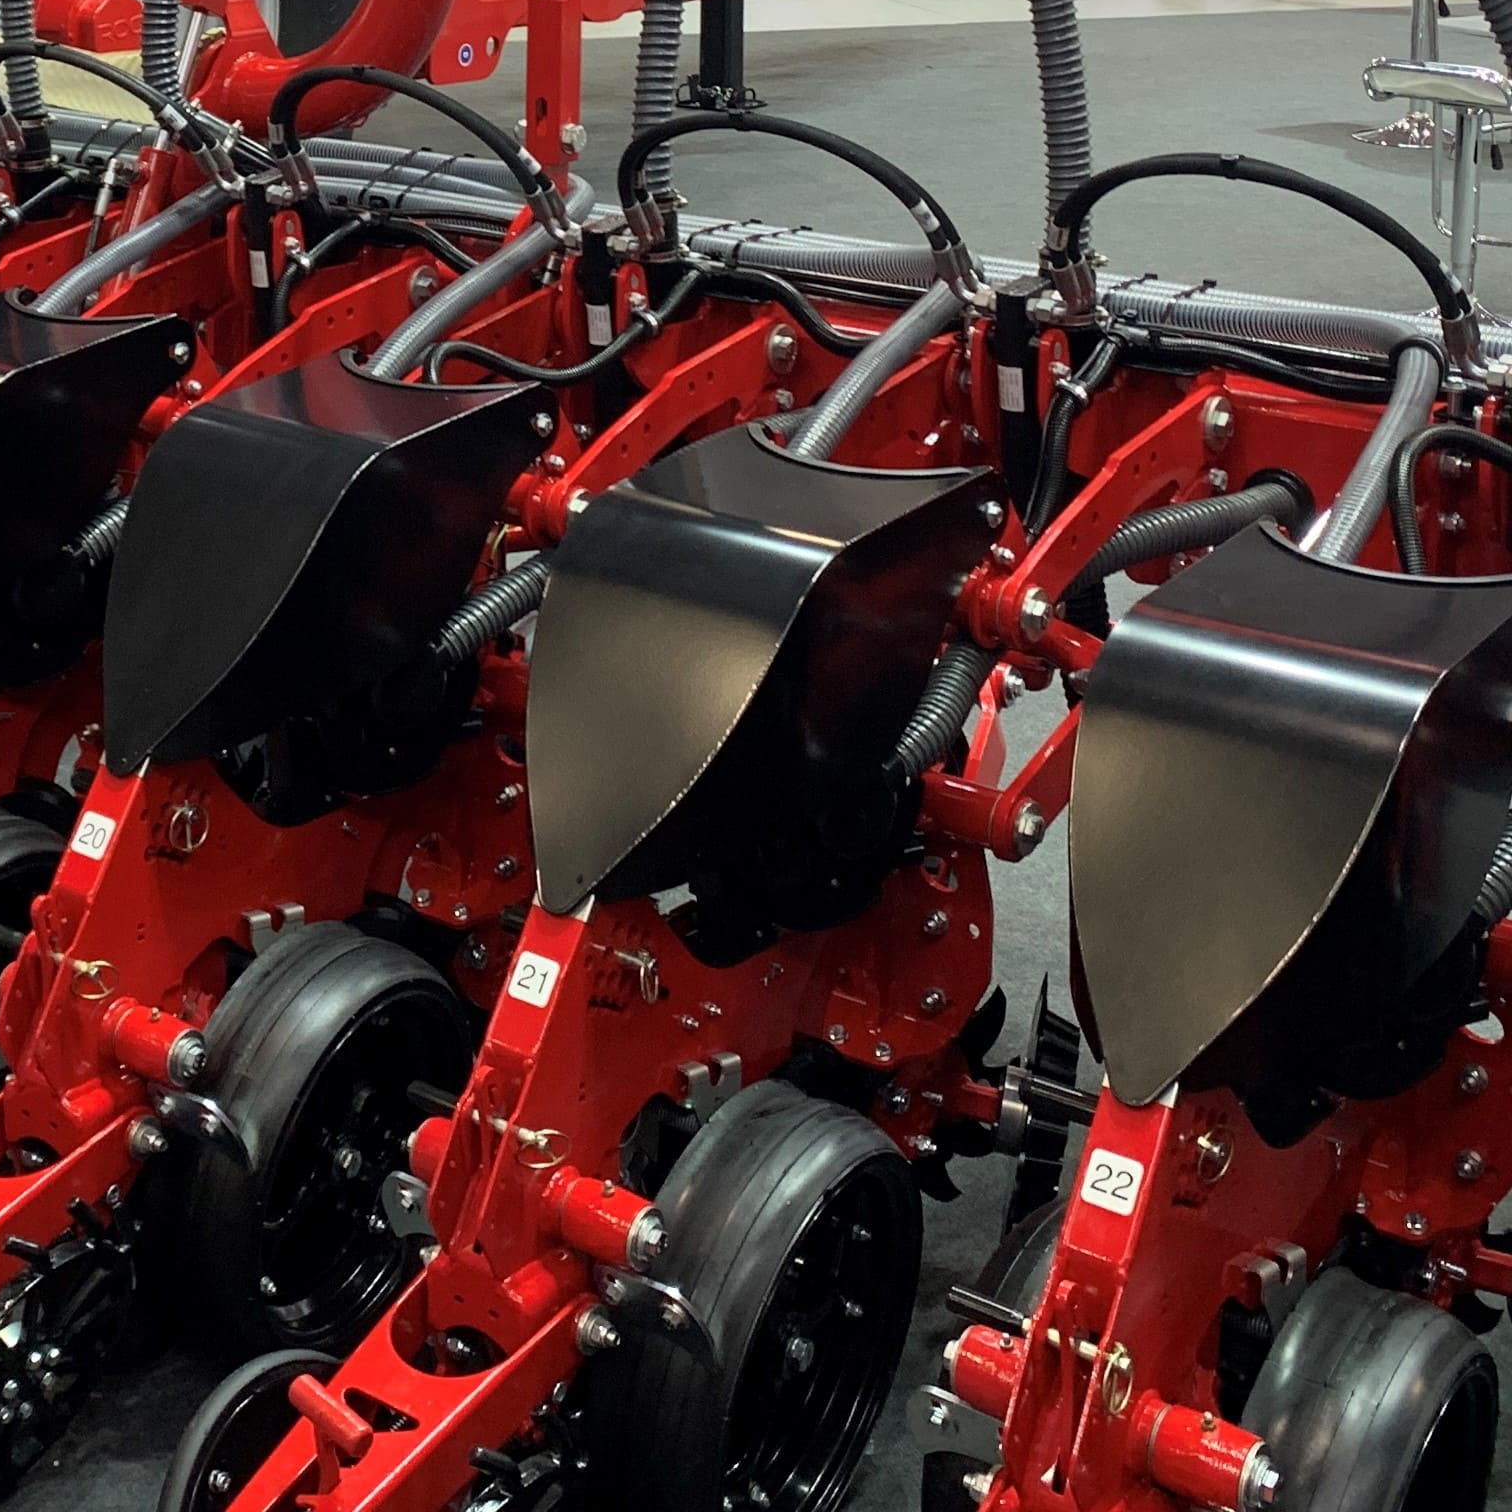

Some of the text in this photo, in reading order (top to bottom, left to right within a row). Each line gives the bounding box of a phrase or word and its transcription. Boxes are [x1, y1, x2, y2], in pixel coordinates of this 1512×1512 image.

[78, 823, 107, 850] 20
[518, 965, 549, 993] 21
[1090, 1163, 1135, 1201] 22
